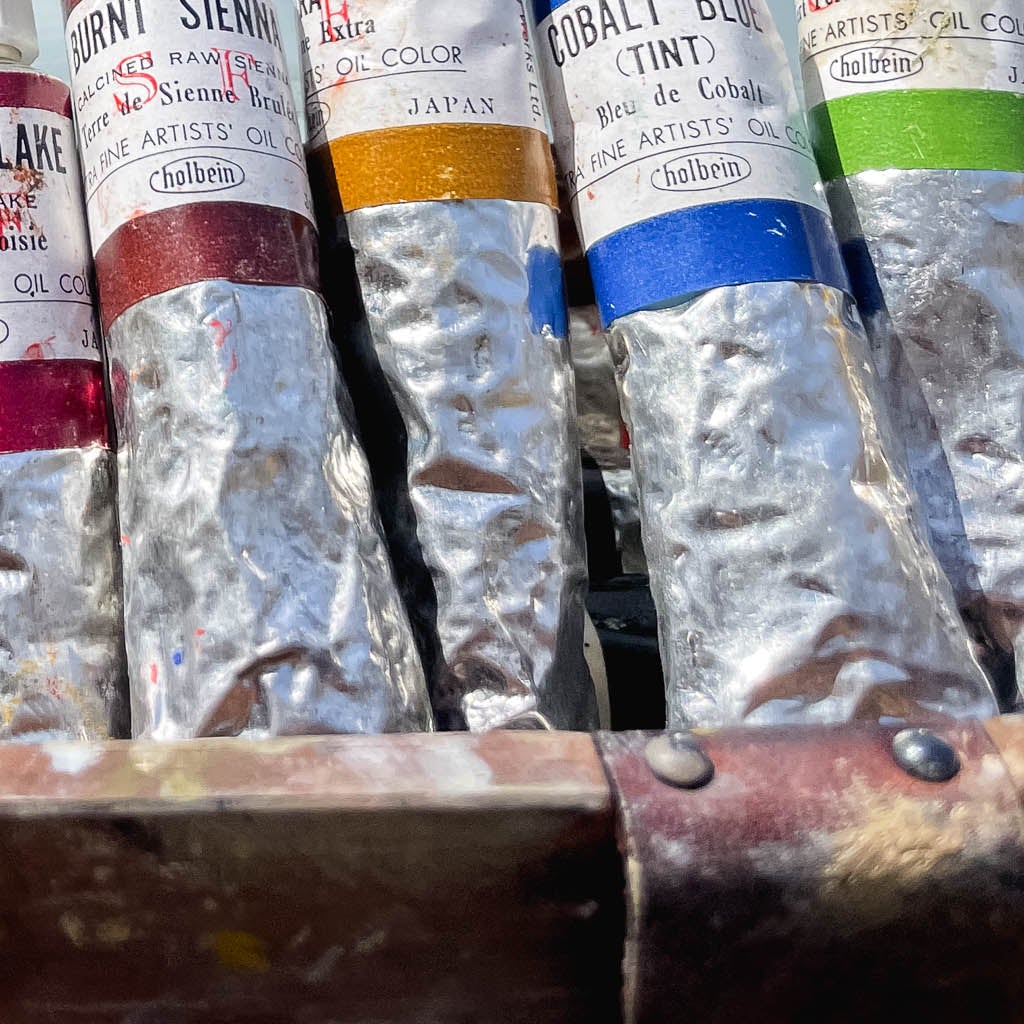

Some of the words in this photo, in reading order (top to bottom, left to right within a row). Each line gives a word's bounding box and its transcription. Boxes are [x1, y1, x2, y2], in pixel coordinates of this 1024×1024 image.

[320, 18, 376, 44] Extra
[801, 29, 817, 53] NE
[826, 11, 915, 41] ARTISTS'
[981, 12, 1024, 36] COL
[336, 55, 370, 76] OIL
[382, 45, 463, 67] COLOR
[616, 34, 716, 77] (TINT)
[840, 52, 911, 78] holbein
[77, 56, 154, 112] CALCINED
[169, 51, 221, 65] RAW
[1008, 65, 1024, 84] J
[81, 112, 110, 149] Terre
[121, 91, 143, 116] de
[159, 81, 236, 106] Sienne
[408, 96, 495, 115] JAPAN
[528, 81, 542, 123] Ltd.
[596, 99, 637, 130] Bleu
[654, 83, 681, 107] de
[698, 76, 764, 104] Cobalt
[86, 165, 98, 189] RA
[99, 137, 130, 173] FINE
[141, 122, 233, 150] ARTISTS'
[246, 125, 278, 149] OIL
[567, 166, 585, 189] RA
[591, 139, 627, 173] FINE
[639, 117, 734, 149] ARTISTS'
[747, 118, 780, 139] OIL
[784, 126, 811, 150] CO
[163, 160, 235, 190] holbein
[663, 156, 742, 187] holbein
[14, 273, 50, 297] OIL
